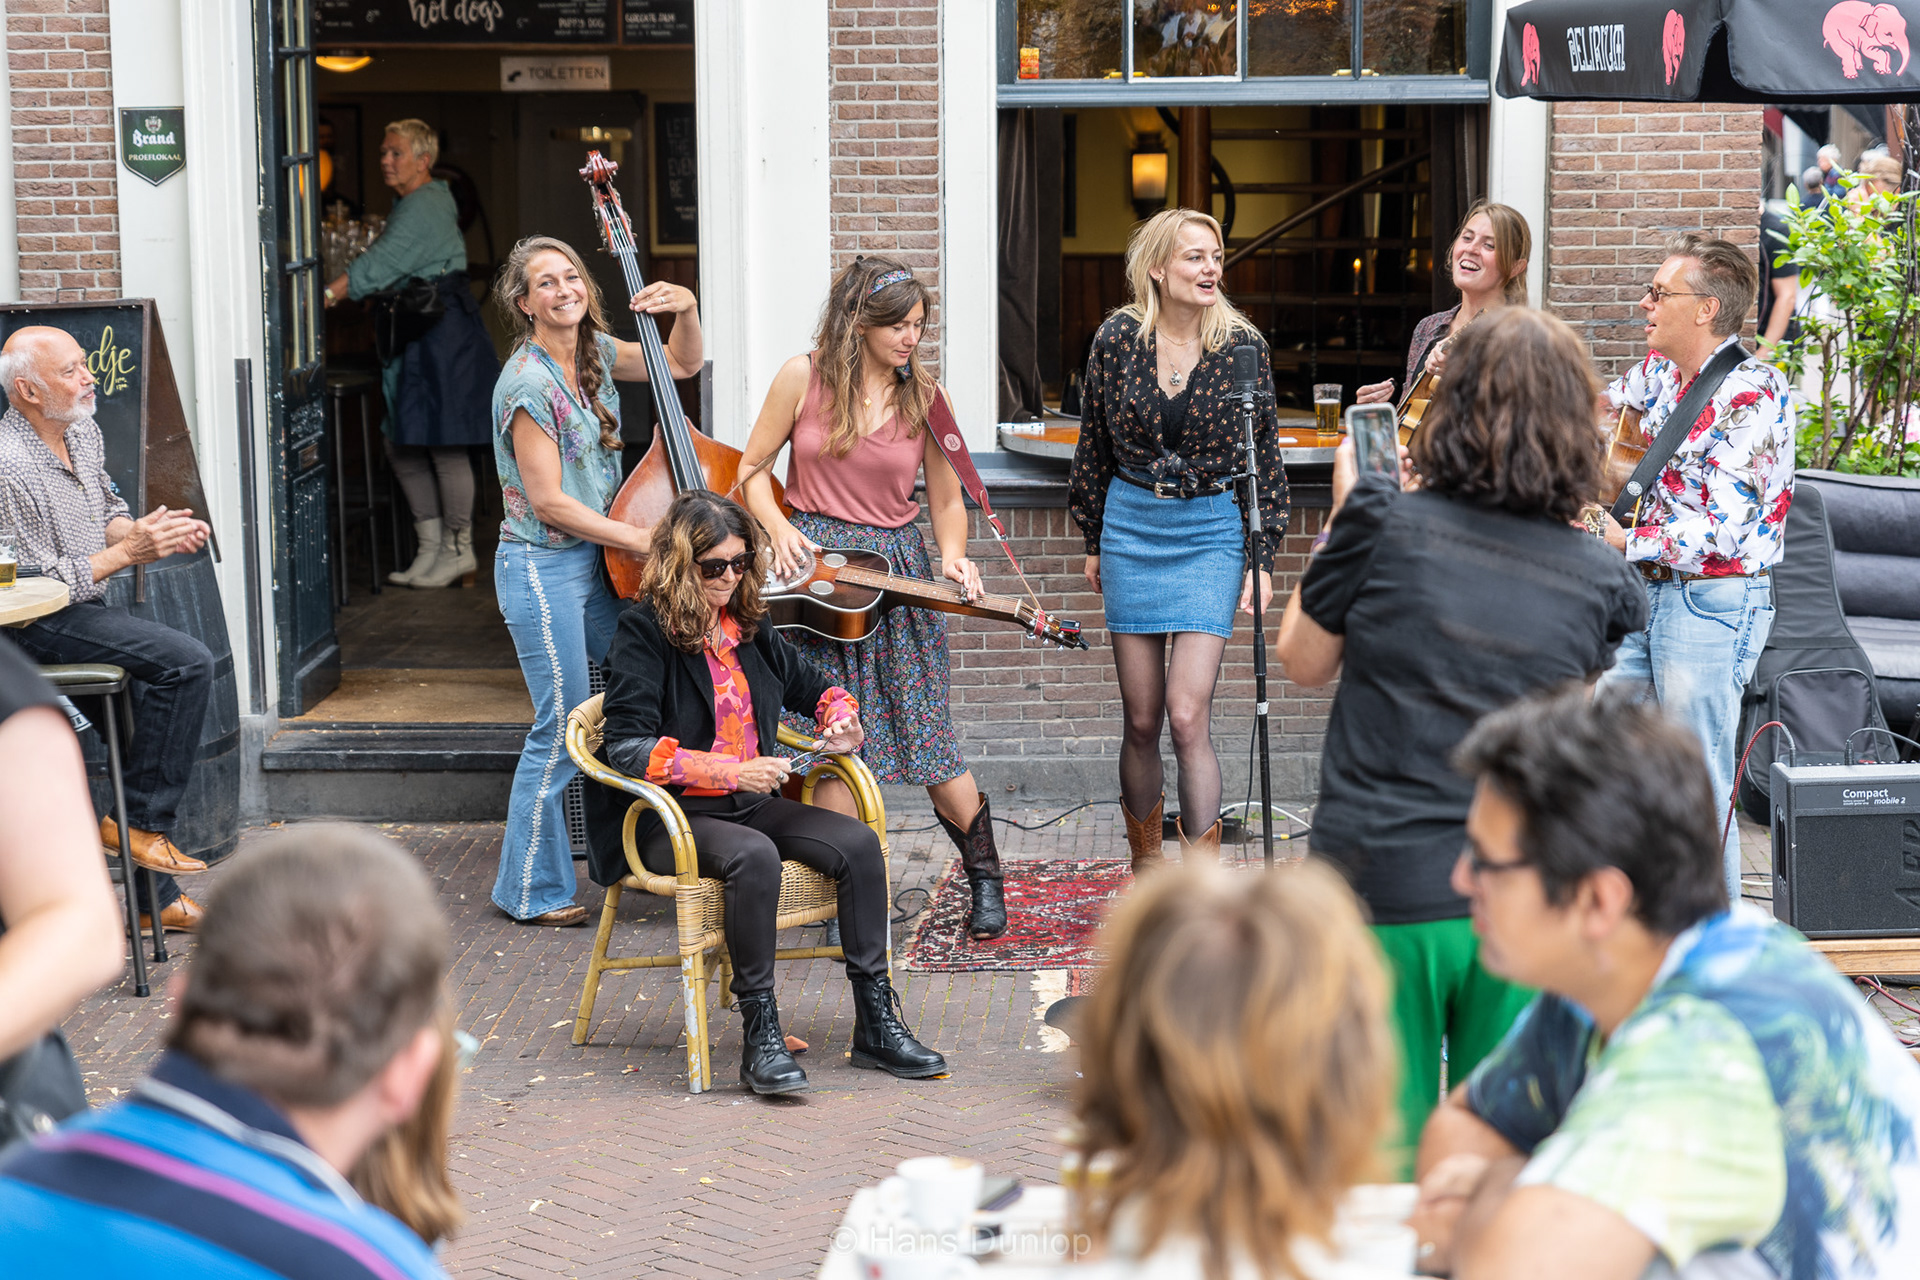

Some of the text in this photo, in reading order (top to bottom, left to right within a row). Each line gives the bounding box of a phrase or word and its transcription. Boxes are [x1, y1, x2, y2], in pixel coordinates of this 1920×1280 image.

[453, 0, 503, 32] dogs
[1566, 24, 1626, 72] DELIRIUM
[527, 66, 605, 80] TOILETTEN
[132, 128, 176, 147] Brand
[128, 153, 181, 161] PROEFLOKAAL
[1842, 788, 1889, 800] Compact
[1873, 797, 1899, 805] mobile
